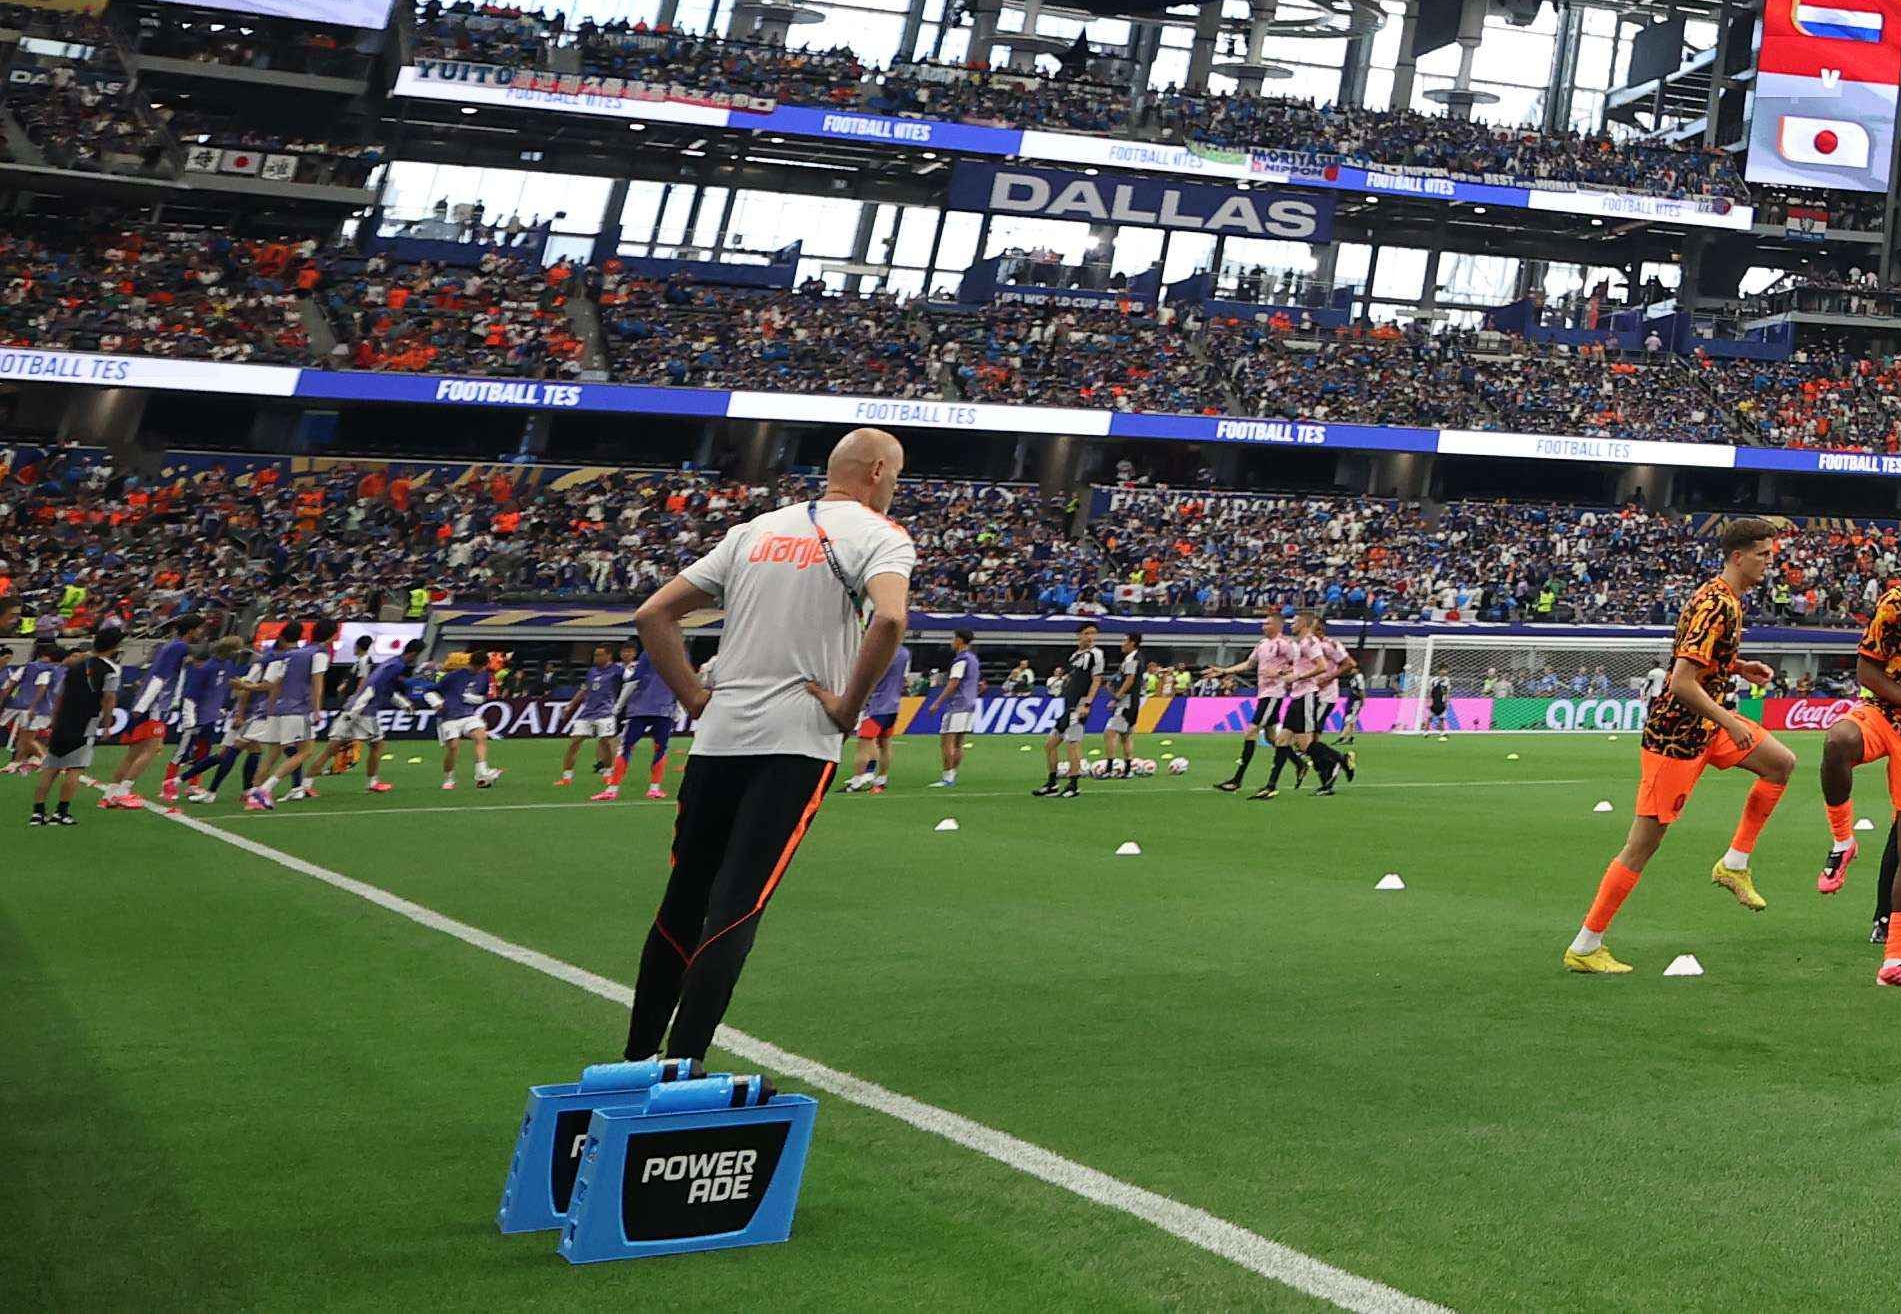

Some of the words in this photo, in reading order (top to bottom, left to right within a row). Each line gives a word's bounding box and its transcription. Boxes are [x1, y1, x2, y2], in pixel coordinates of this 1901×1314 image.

[822, 115, 892, 138] FOOTBALL
[1109, 147, 1170, 165] FOOTBALL
[988, 171, 1318, 238] DALLAS
[435, 379, 540, 405] FOOTBALL
[856, 402, 943, 423] FOOTBALL
[1216, 421, 1296, 443] FOOTBALL
[1536, 439, 1602, 457] FOOTBALL
[1818, 453, 1879, 472] FOOTBALL
[972, 696, 1065, 733] VISA
[641, 1148, 758, 1184] POWER
[687, 1174, 752, 1204] ADE
